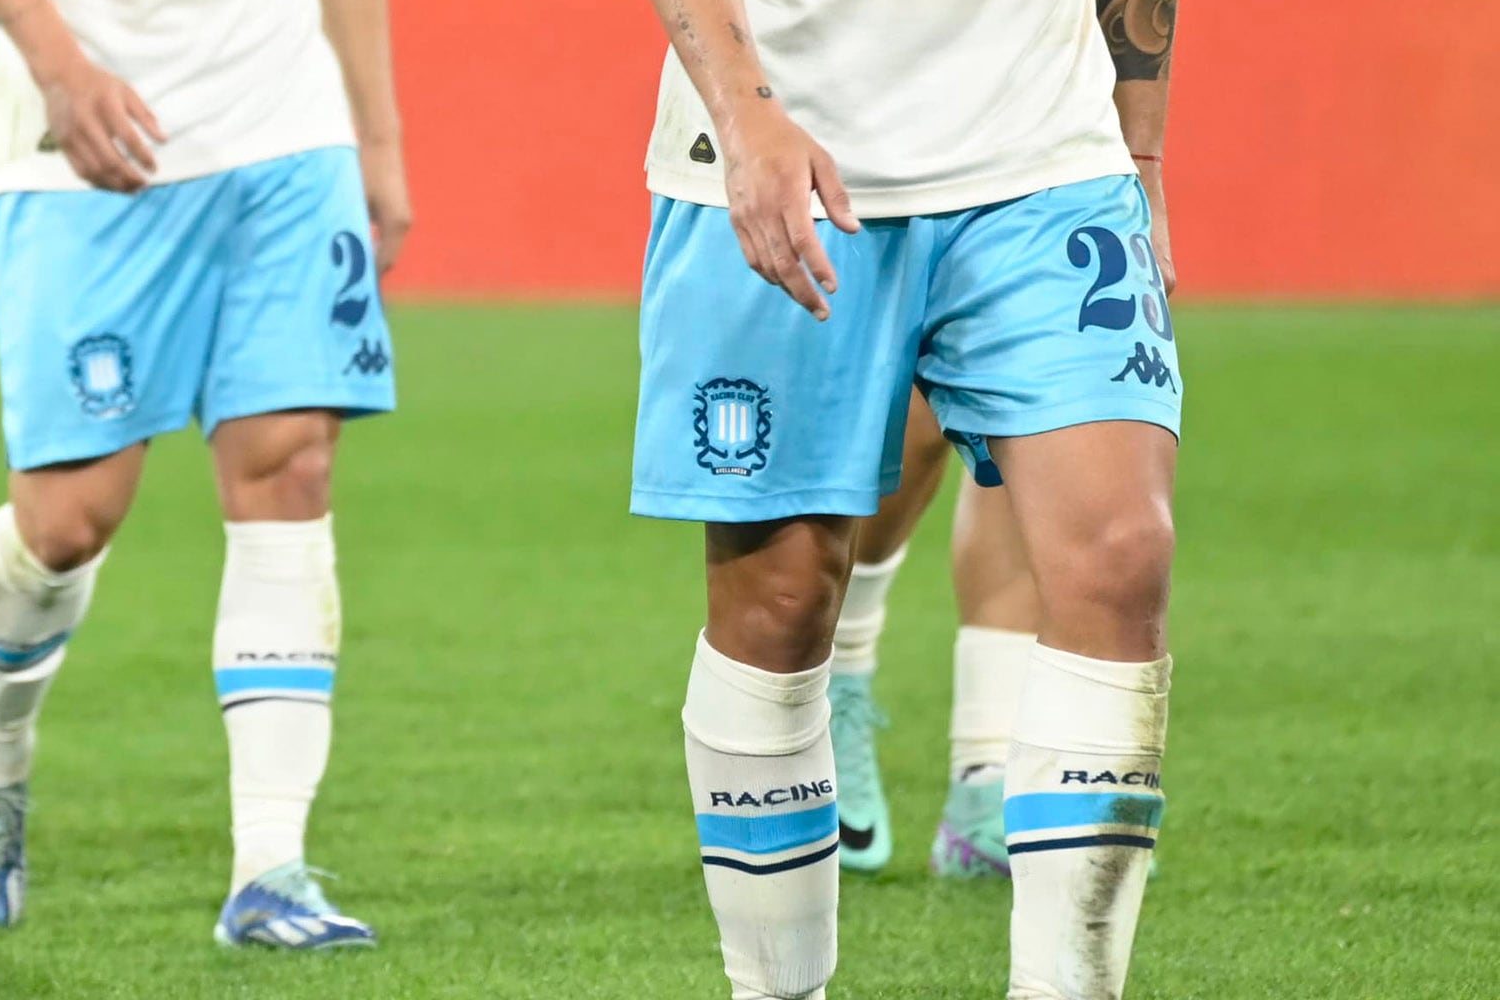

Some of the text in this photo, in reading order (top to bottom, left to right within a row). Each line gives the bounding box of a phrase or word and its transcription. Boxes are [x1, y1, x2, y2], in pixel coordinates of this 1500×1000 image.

[329, 230, 370, 328] 2
[1067, 226, 1173, 342] 23
[710, 779, 833, 807] RACING
